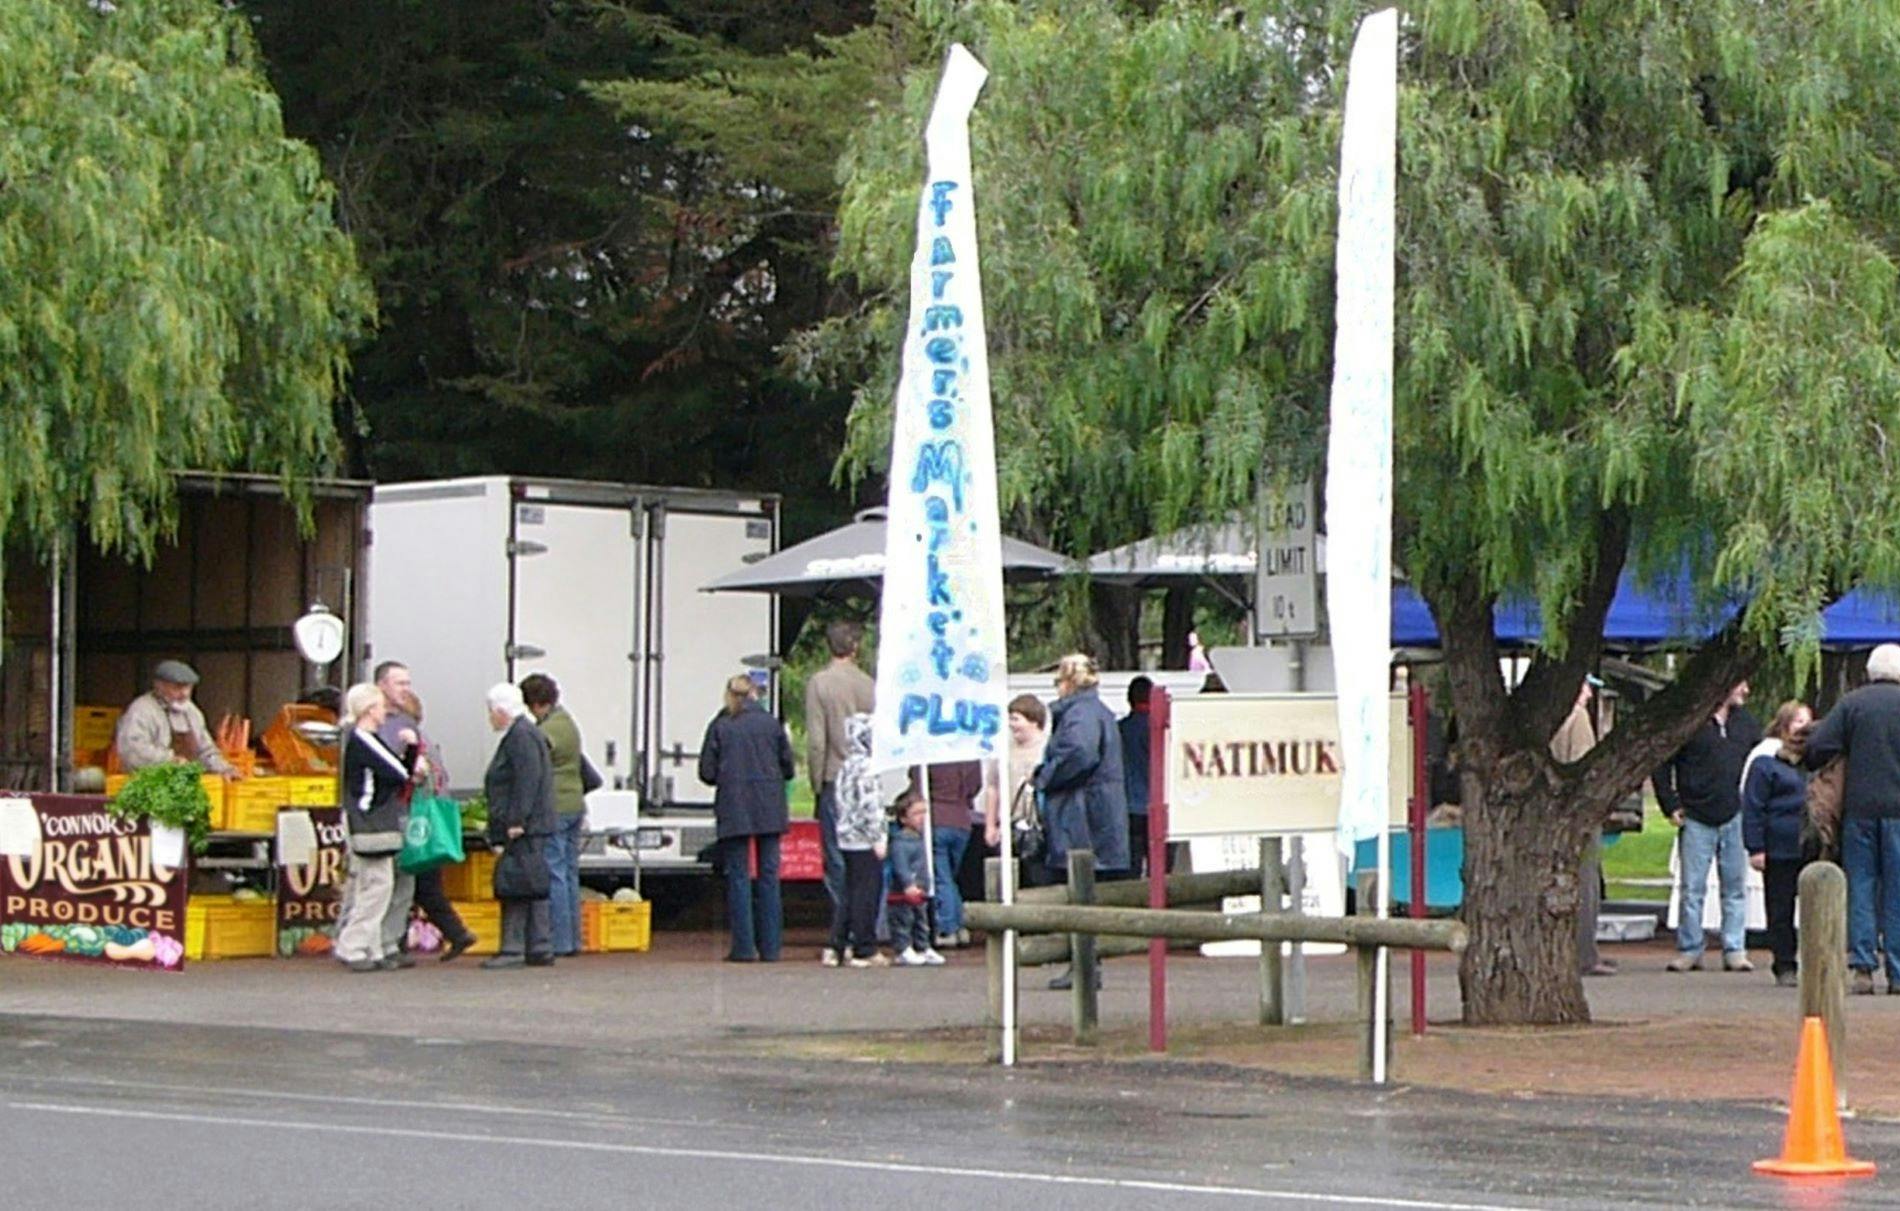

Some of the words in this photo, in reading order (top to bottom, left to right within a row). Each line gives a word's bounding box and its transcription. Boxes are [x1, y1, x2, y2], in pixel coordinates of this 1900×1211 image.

[910, 439, 963, 681] Market
[1266, 547, 1306, 576] LIMIT
[899, 693, 1000, 737] PLUS
[1182, 739, 1338, 778] NATIMUK
[7, 895, 176, 930] PRODUCE
